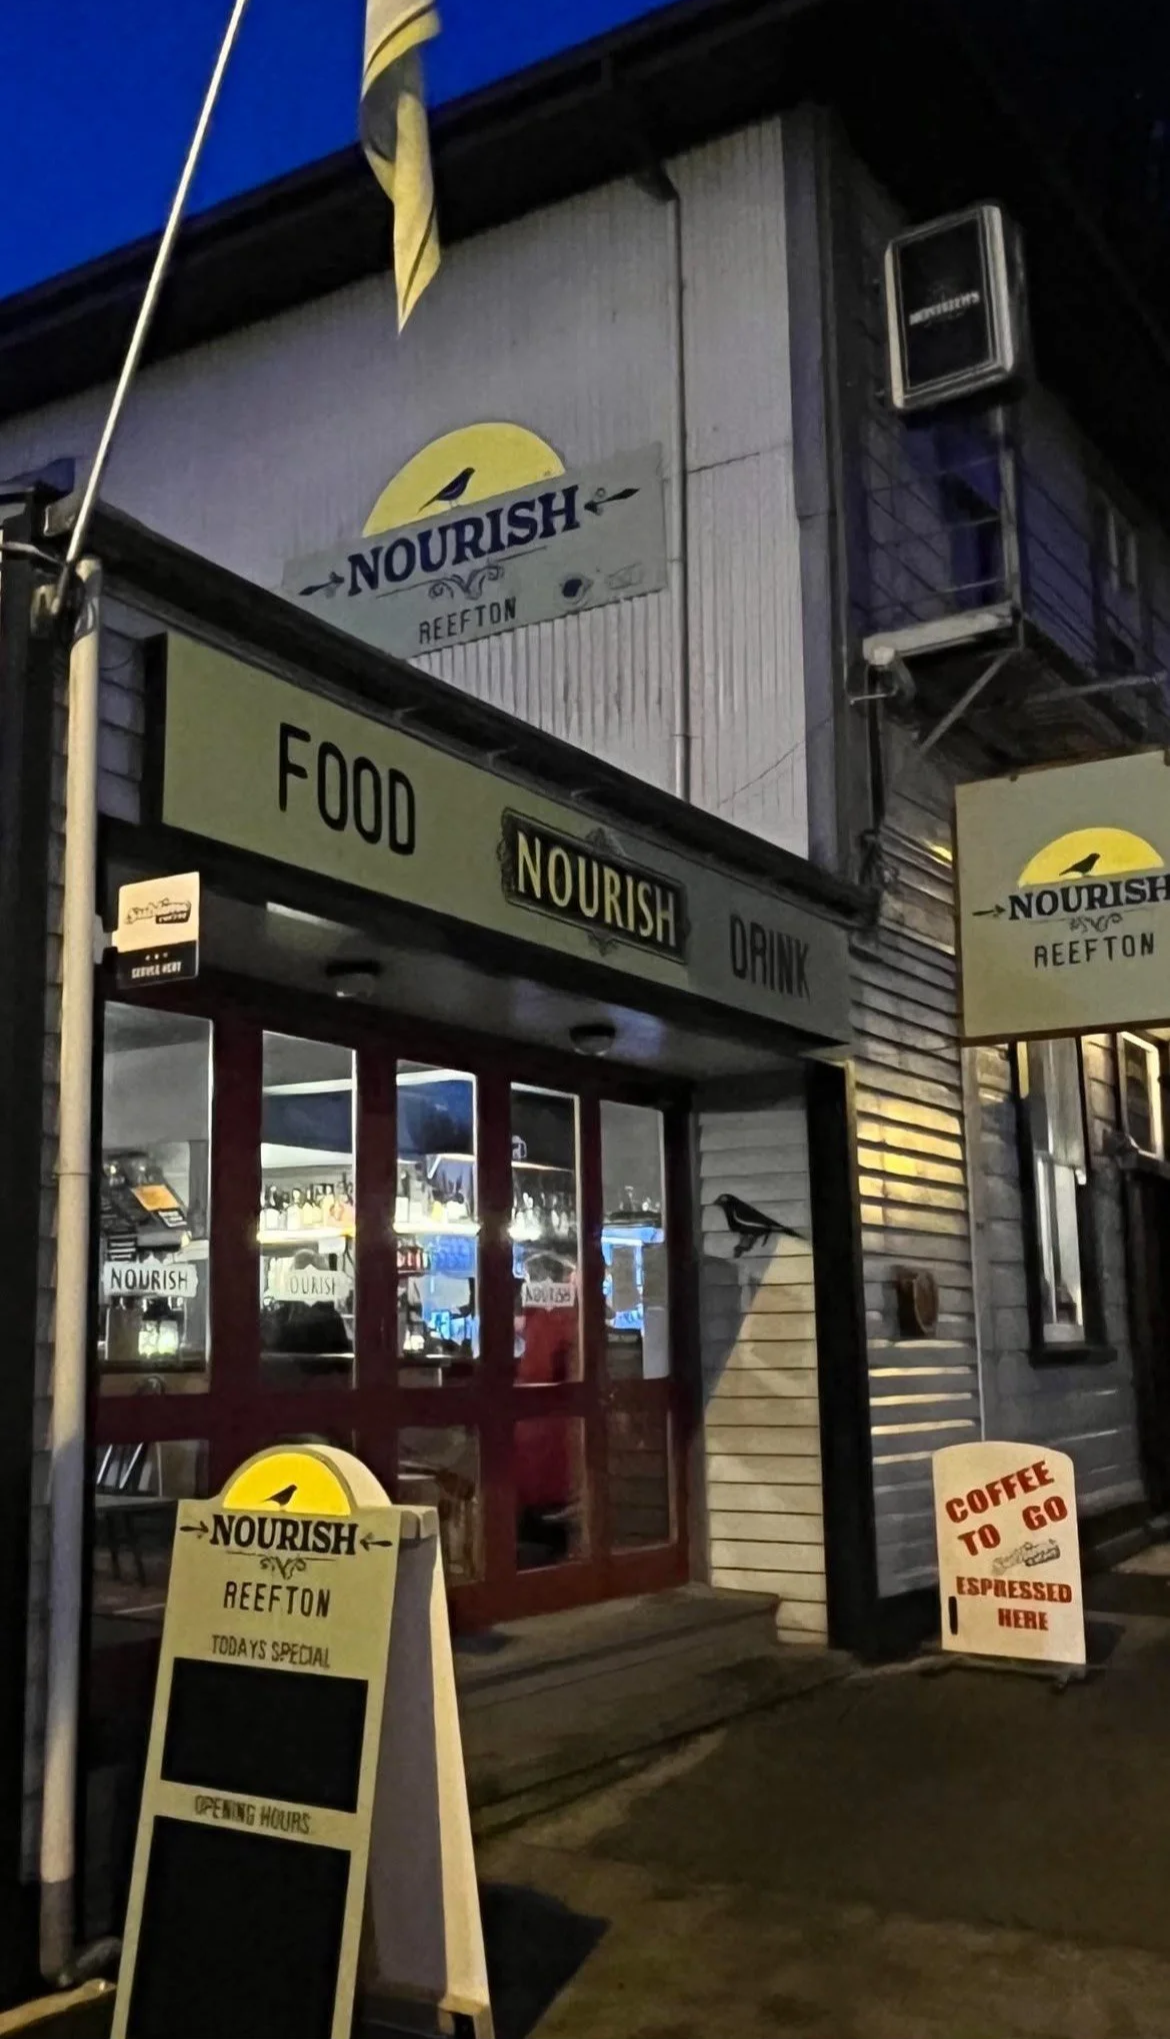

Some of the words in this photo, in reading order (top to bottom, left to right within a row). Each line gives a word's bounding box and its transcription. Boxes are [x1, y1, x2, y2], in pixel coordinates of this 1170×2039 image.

[347, 484, 581, 597] NOURISH
[419, 597, 517, 645] REEFTON
[278, 722, 416, 856] FOOD
[515, 831, 678, 949] NOURISH
[1008, 873, 1170, 921] NOURISH
[730, 913, 811, 1004] DRINK
[1034, 932, 1155, 969] REEFTON
[110, 1267, 187, 1292] NOURISH
[945, 1460, 1055, 1523] COFFEE
[209, 1514, 359, 1556] NOURISH
[957, 1523, 1001, 1556] TO
[1022, 1495, 1068, 1531] GO
[223, 1581, 331, 1618] REEFTON
[956, 1576, 1073, 1604] ESPRESSED
[998, 1608, 1049, 1632] HERE
[211, 1634, 267, 1662] TODAYS
[271, 1642, 330, 1669] SPECIAL
[195, 1795, 256, 1826] OPENING
[260, 1805, 311, 1835] HOURS
